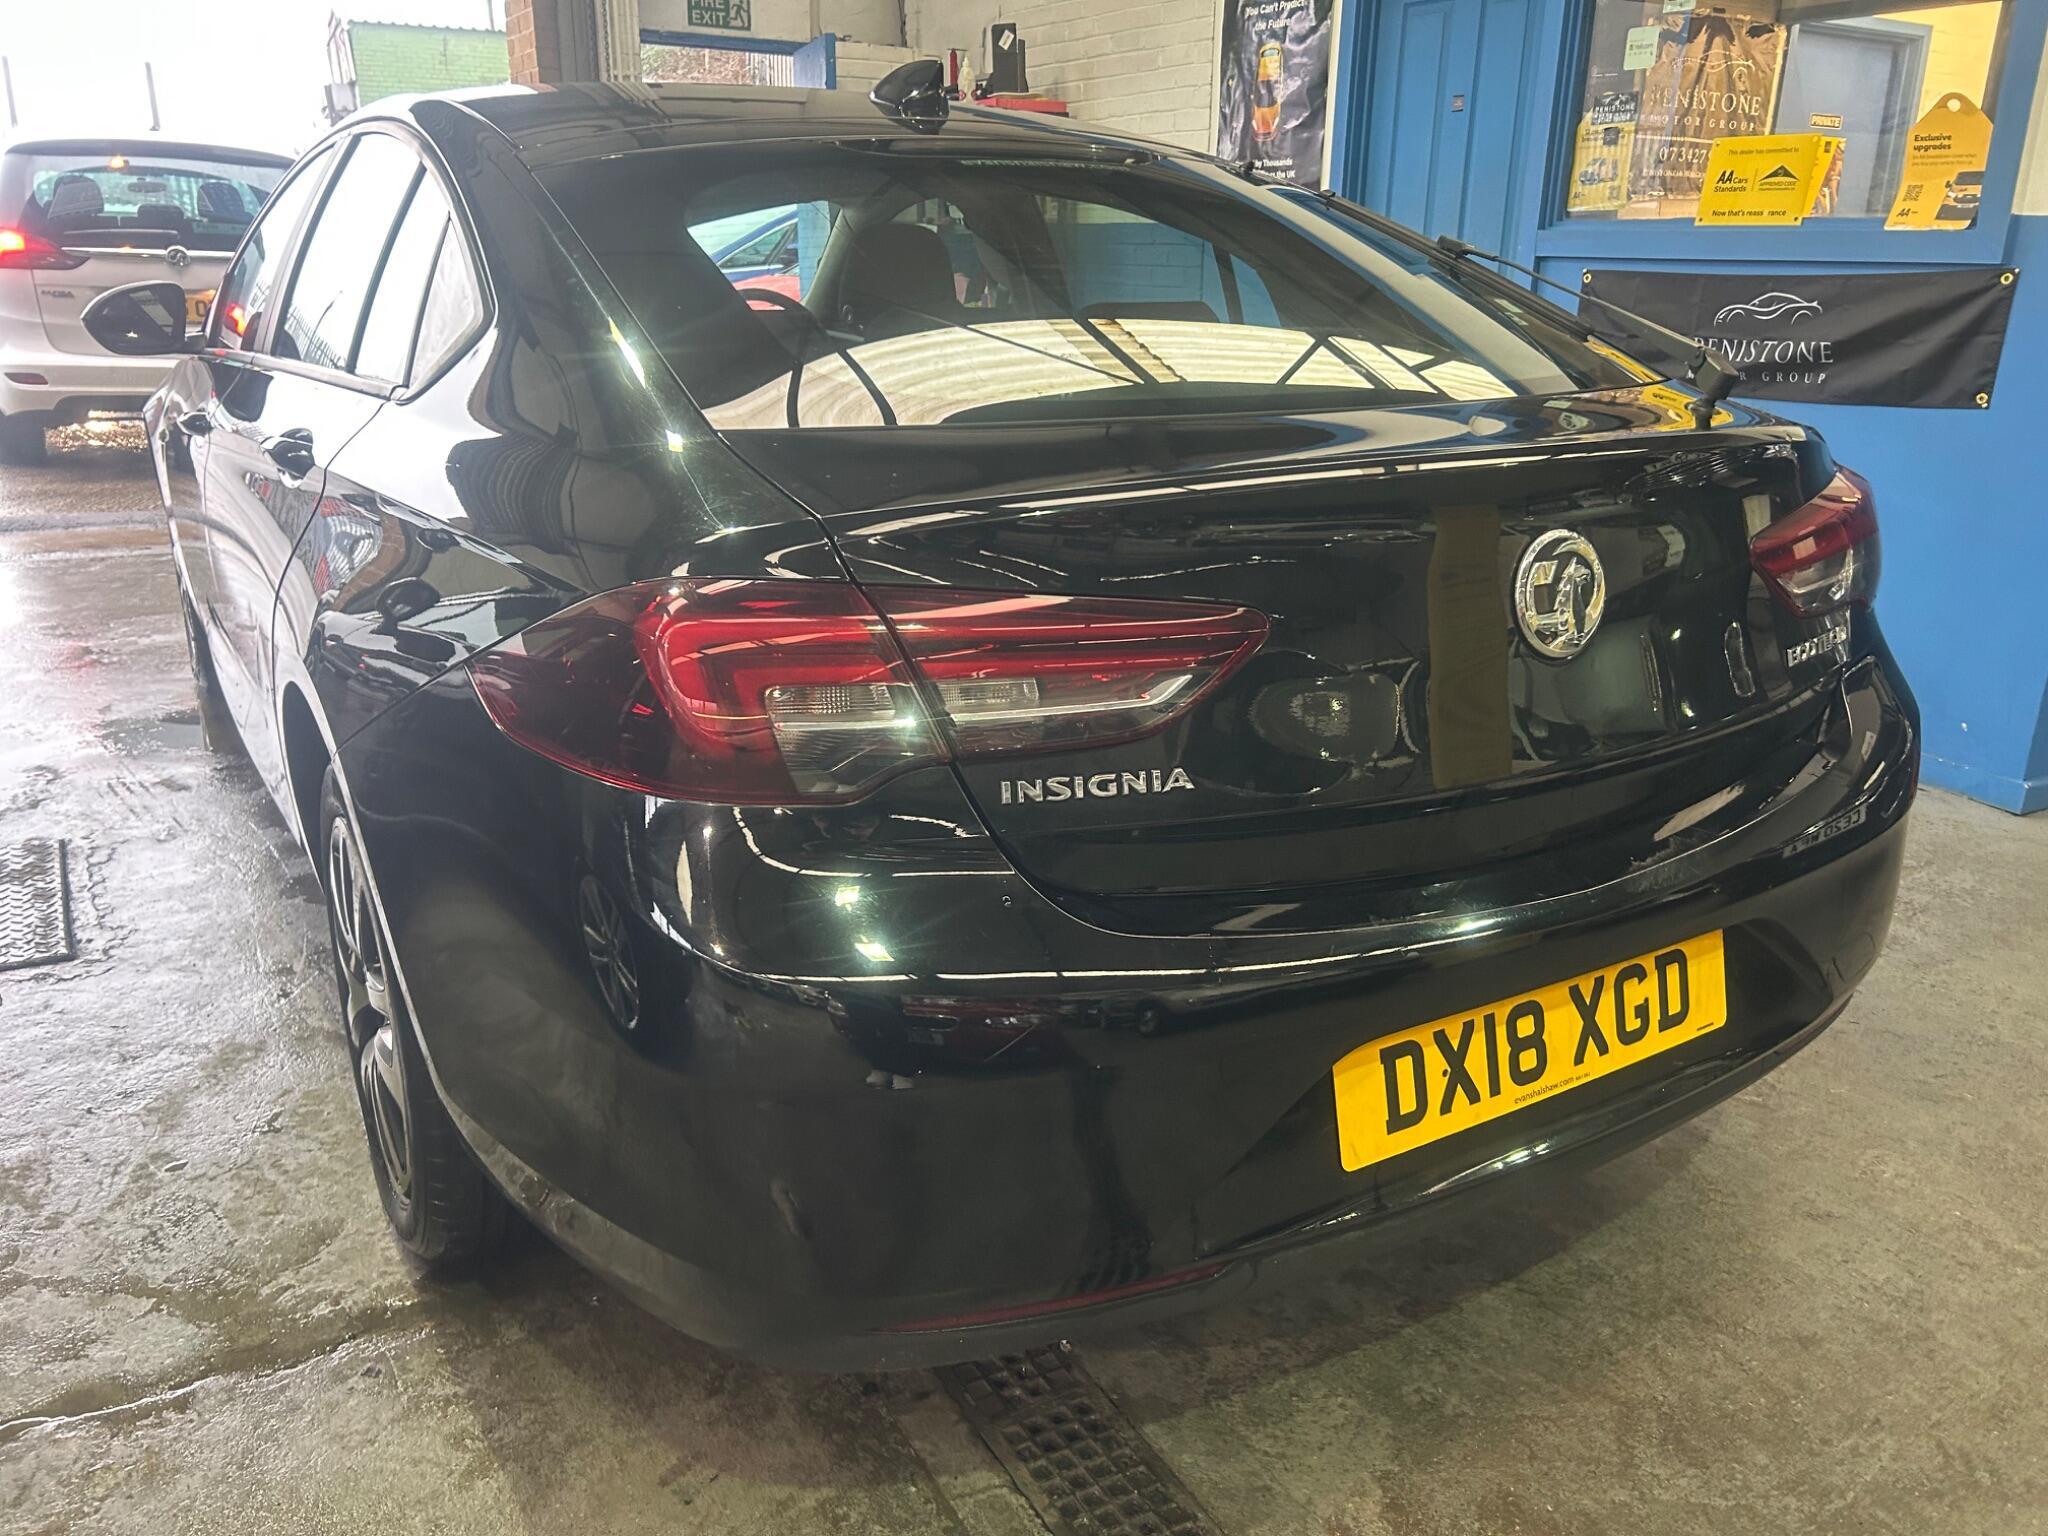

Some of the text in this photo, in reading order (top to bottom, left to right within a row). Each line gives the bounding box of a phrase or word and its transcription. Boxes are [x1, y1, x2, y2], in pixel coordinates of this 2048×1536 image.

[1245, 5, 1259, 17] You
[1260, 2, 1279, 13] Can't
[692, 10, 726, 25] EXIT
[1254, 20, 1266, 31] the
[1914, 134, 1952, 142] Exclusive
[1913, 142, 1952, 152] upgrades
[1286, 170, 1296, 178] UK
[1716, 170, 1734, 184] AA
[1733, 176, 1748, 184] Cars
[1713, 185, 1747, 193] Standards
[1727, 209, 1745, 217] that's
[1761, 371, 1826, 384] GROUP
[1000, 767, 1195, 805] INSIGNIA
[1379, 948, 1691, 1136] DX18 XGD
[1514, 1077, 1575, 1104] evanshalshaw.com
